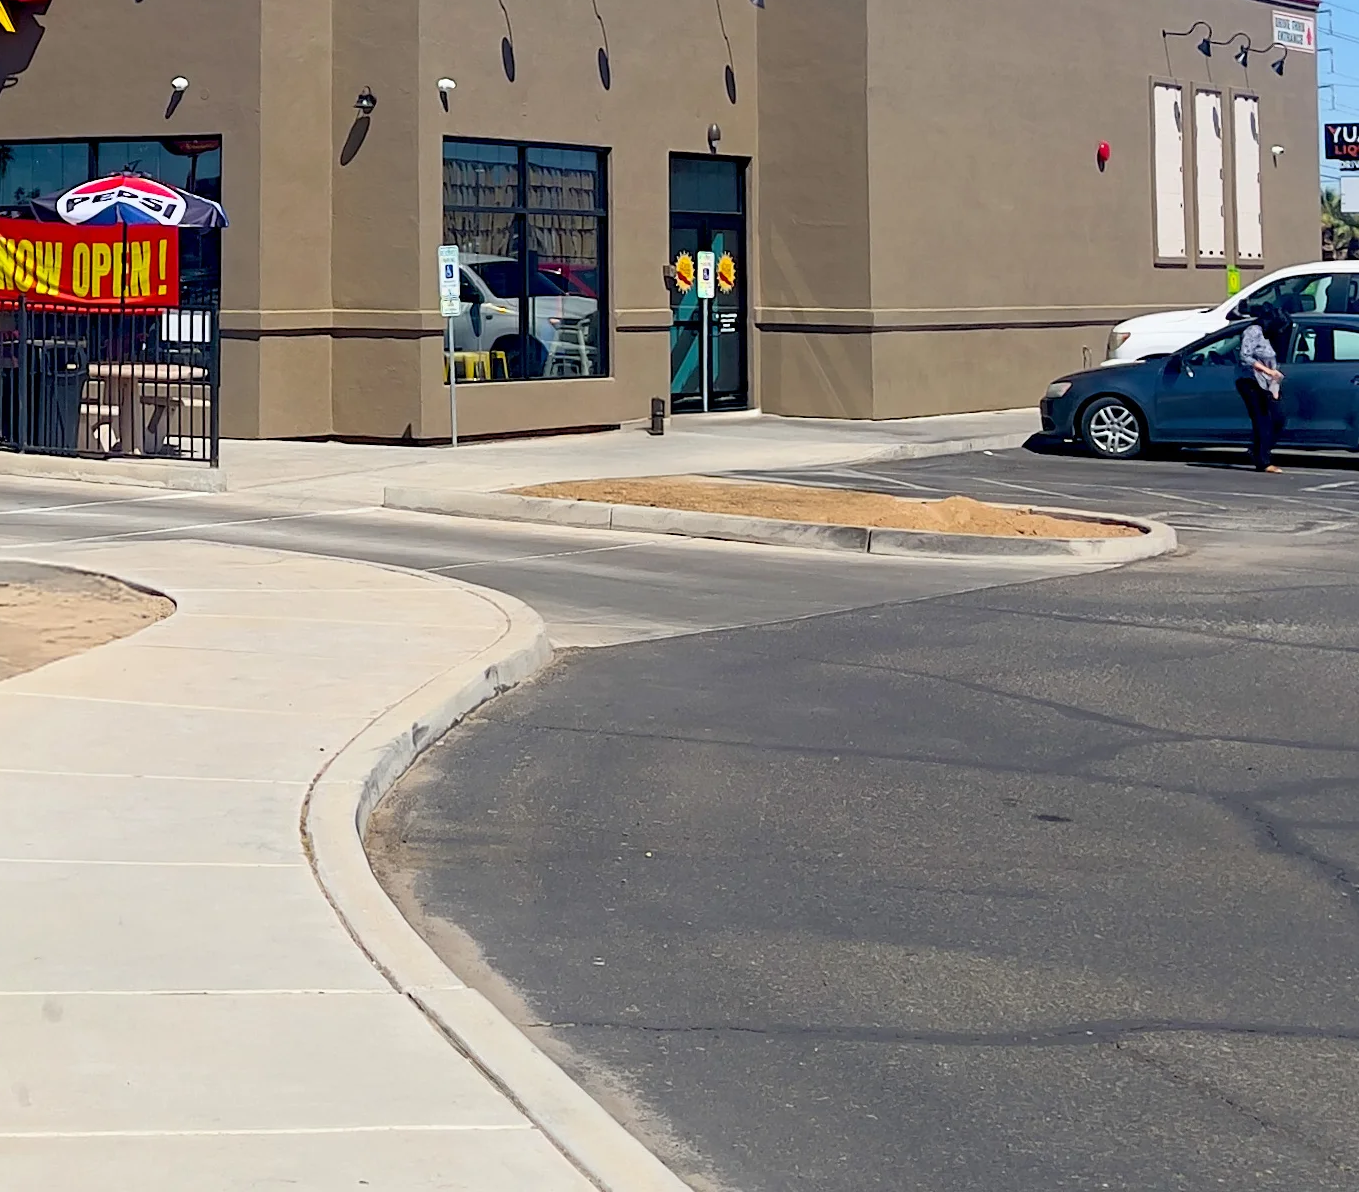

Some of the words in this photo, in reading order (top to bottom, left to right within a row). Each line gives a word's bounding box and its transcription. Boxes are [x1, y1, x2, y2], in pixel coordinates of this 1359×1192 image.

[1327, 125, 1359, 144] YU
[1334, 144, 1359, 157] LIQ
[66, 189, 178, 220] PEPSI
